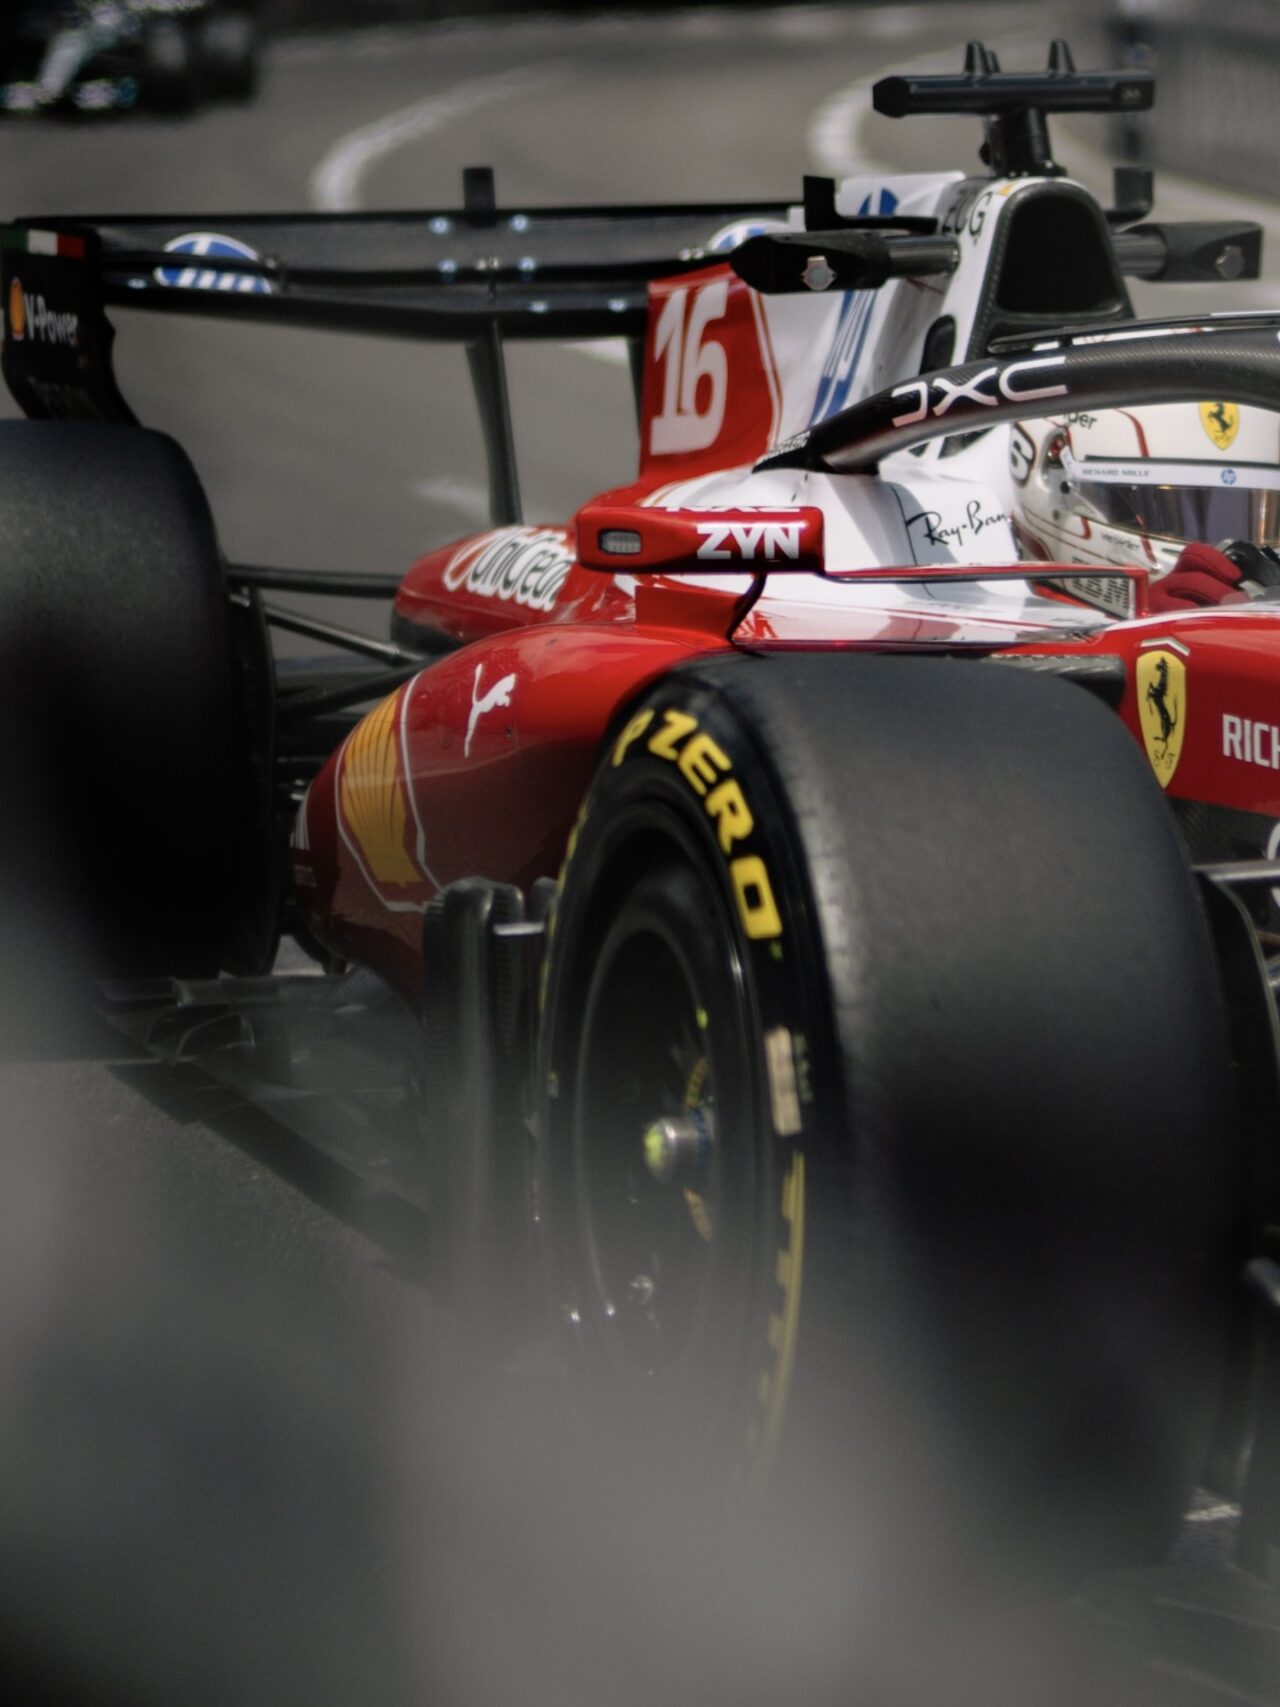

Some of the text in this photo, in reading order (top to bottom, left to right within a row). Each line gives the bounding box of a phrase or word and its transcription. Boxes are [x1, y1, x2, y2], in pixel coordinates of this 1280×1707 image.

[654, 279, 730, 456] 16
[697, 522, 800, 560] ZYN
[906, 500, 1006, 547] Ray-Ban
[648, 709, 783, 940] ZERO
